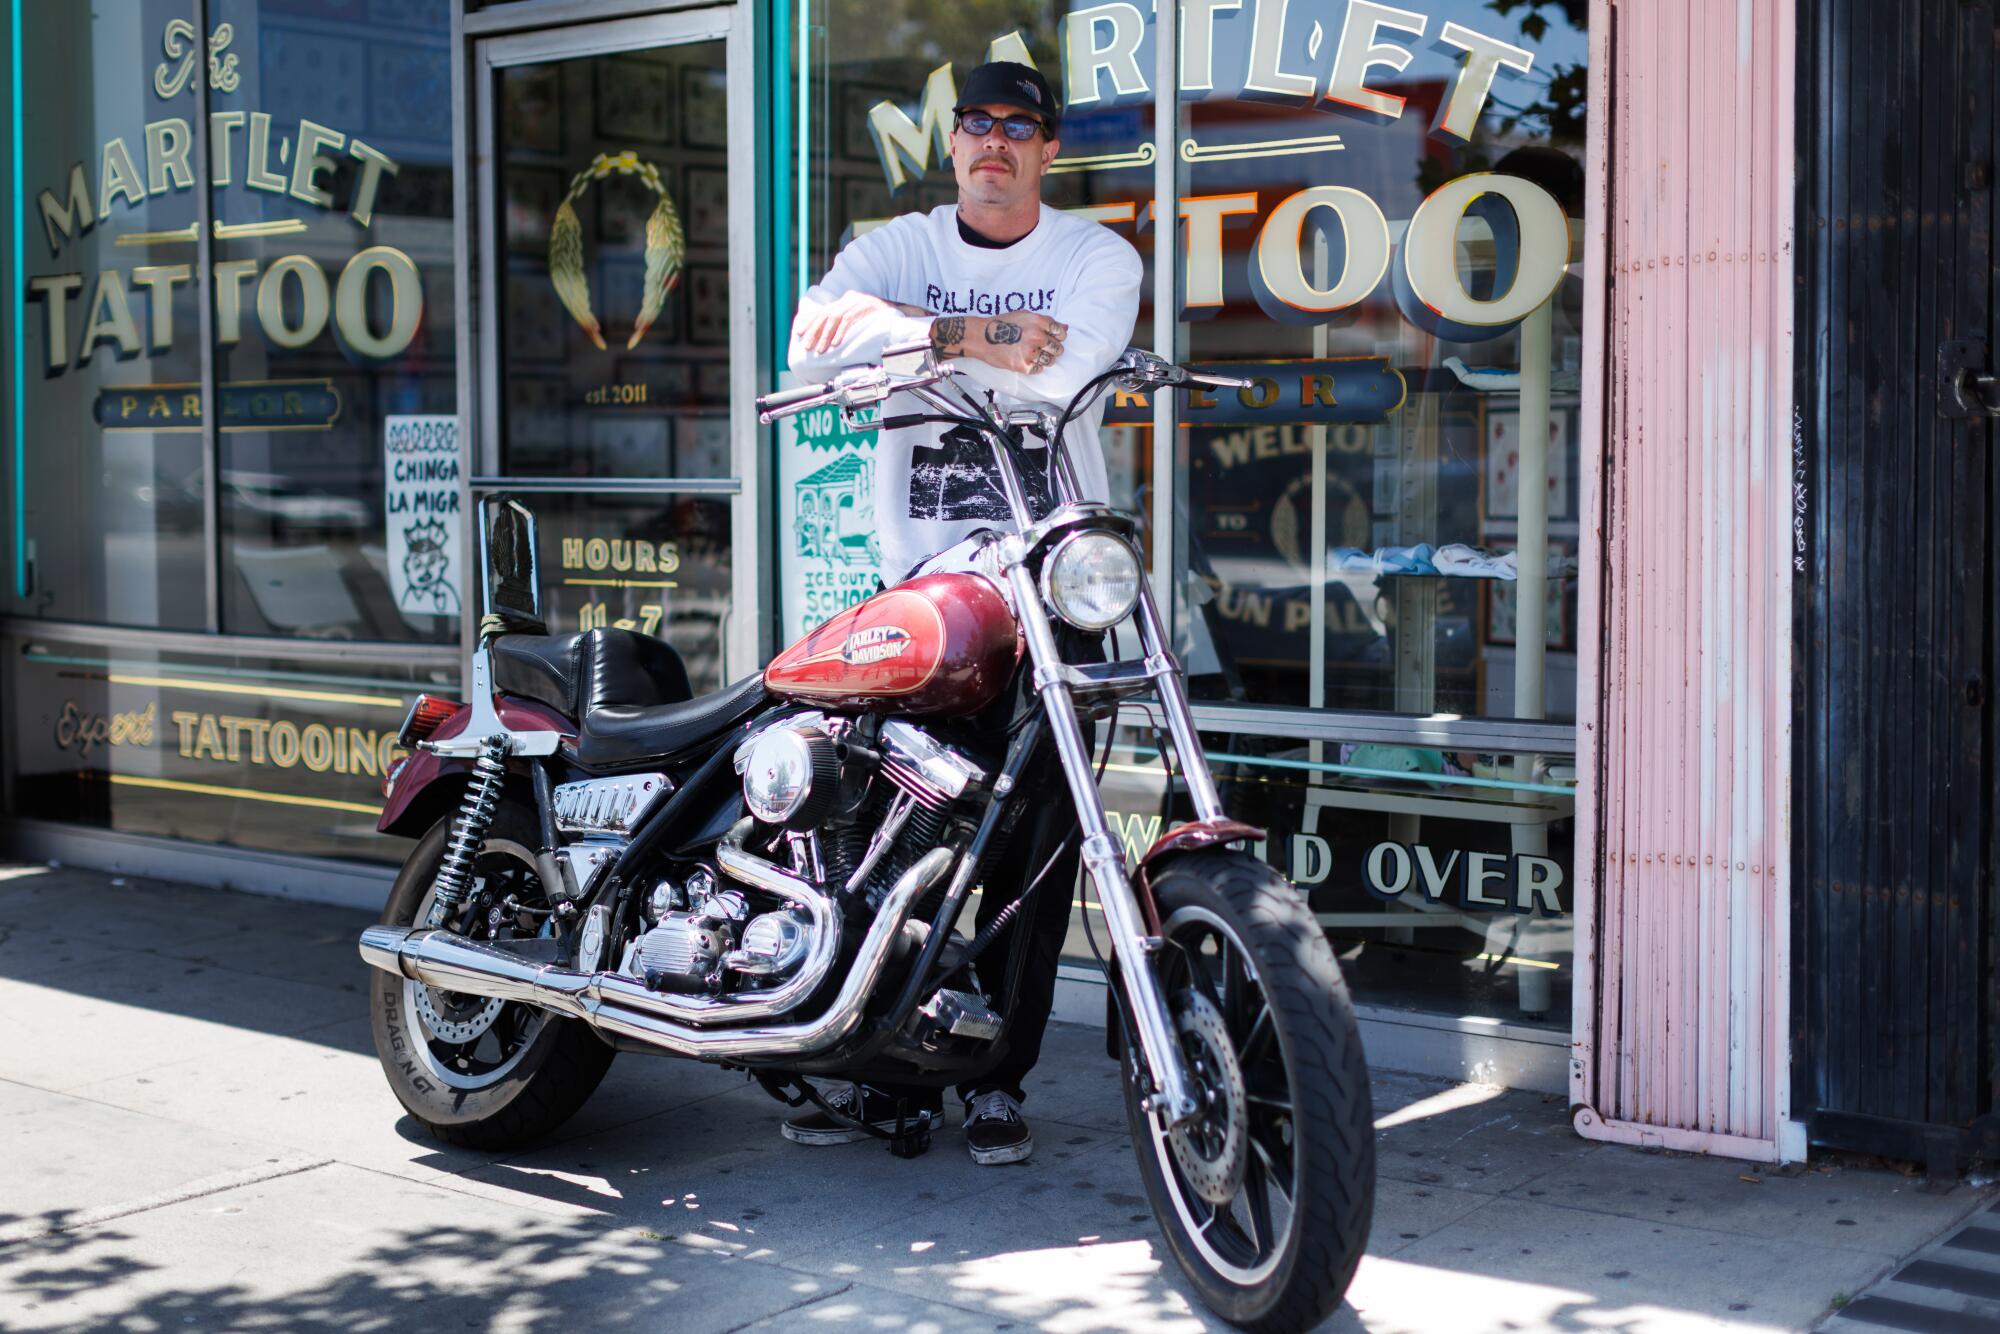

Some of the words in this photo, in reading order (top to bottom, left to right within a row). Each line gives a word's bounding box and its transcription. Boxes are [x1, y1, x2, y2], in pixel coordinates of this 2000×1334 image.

[155, 19, 240, 100] The
[38, 111, 398, 256] MARTLET
[852, 172, 1571, 326] TOO
[31, 246, 423, 369] TATTOO
[121, 390, 304, 418] PARLOR
[611, 383, 647, 405] 2011
[1114, 374, 1338, 408] RLOR
[1210, 425, 1373, 468] WELCO
[394, 459, 459, 481] CHINGA
[389, 491, 408, 513] LA
[413, 490, 460, 513] MIGR
[1216, 514, 1247, 530] TO
[562, 538, 680, 573] HOURS
[804, 572, 834, 588] ICE
[839, 573, 866, 586] OUT
[871, 573, 881, 587] O
[579, 602, 606, 632] 11
[640, 605, 662, 636] 7
[851, 640, 902, 664] DAVIDSON
[172, 711, 409, 776] TATTOOING
[1367, 841, 1564, 911] OVER
[384, 992, 418, 1077] DRAGN
[413, 1075, 435, 1096] GT
